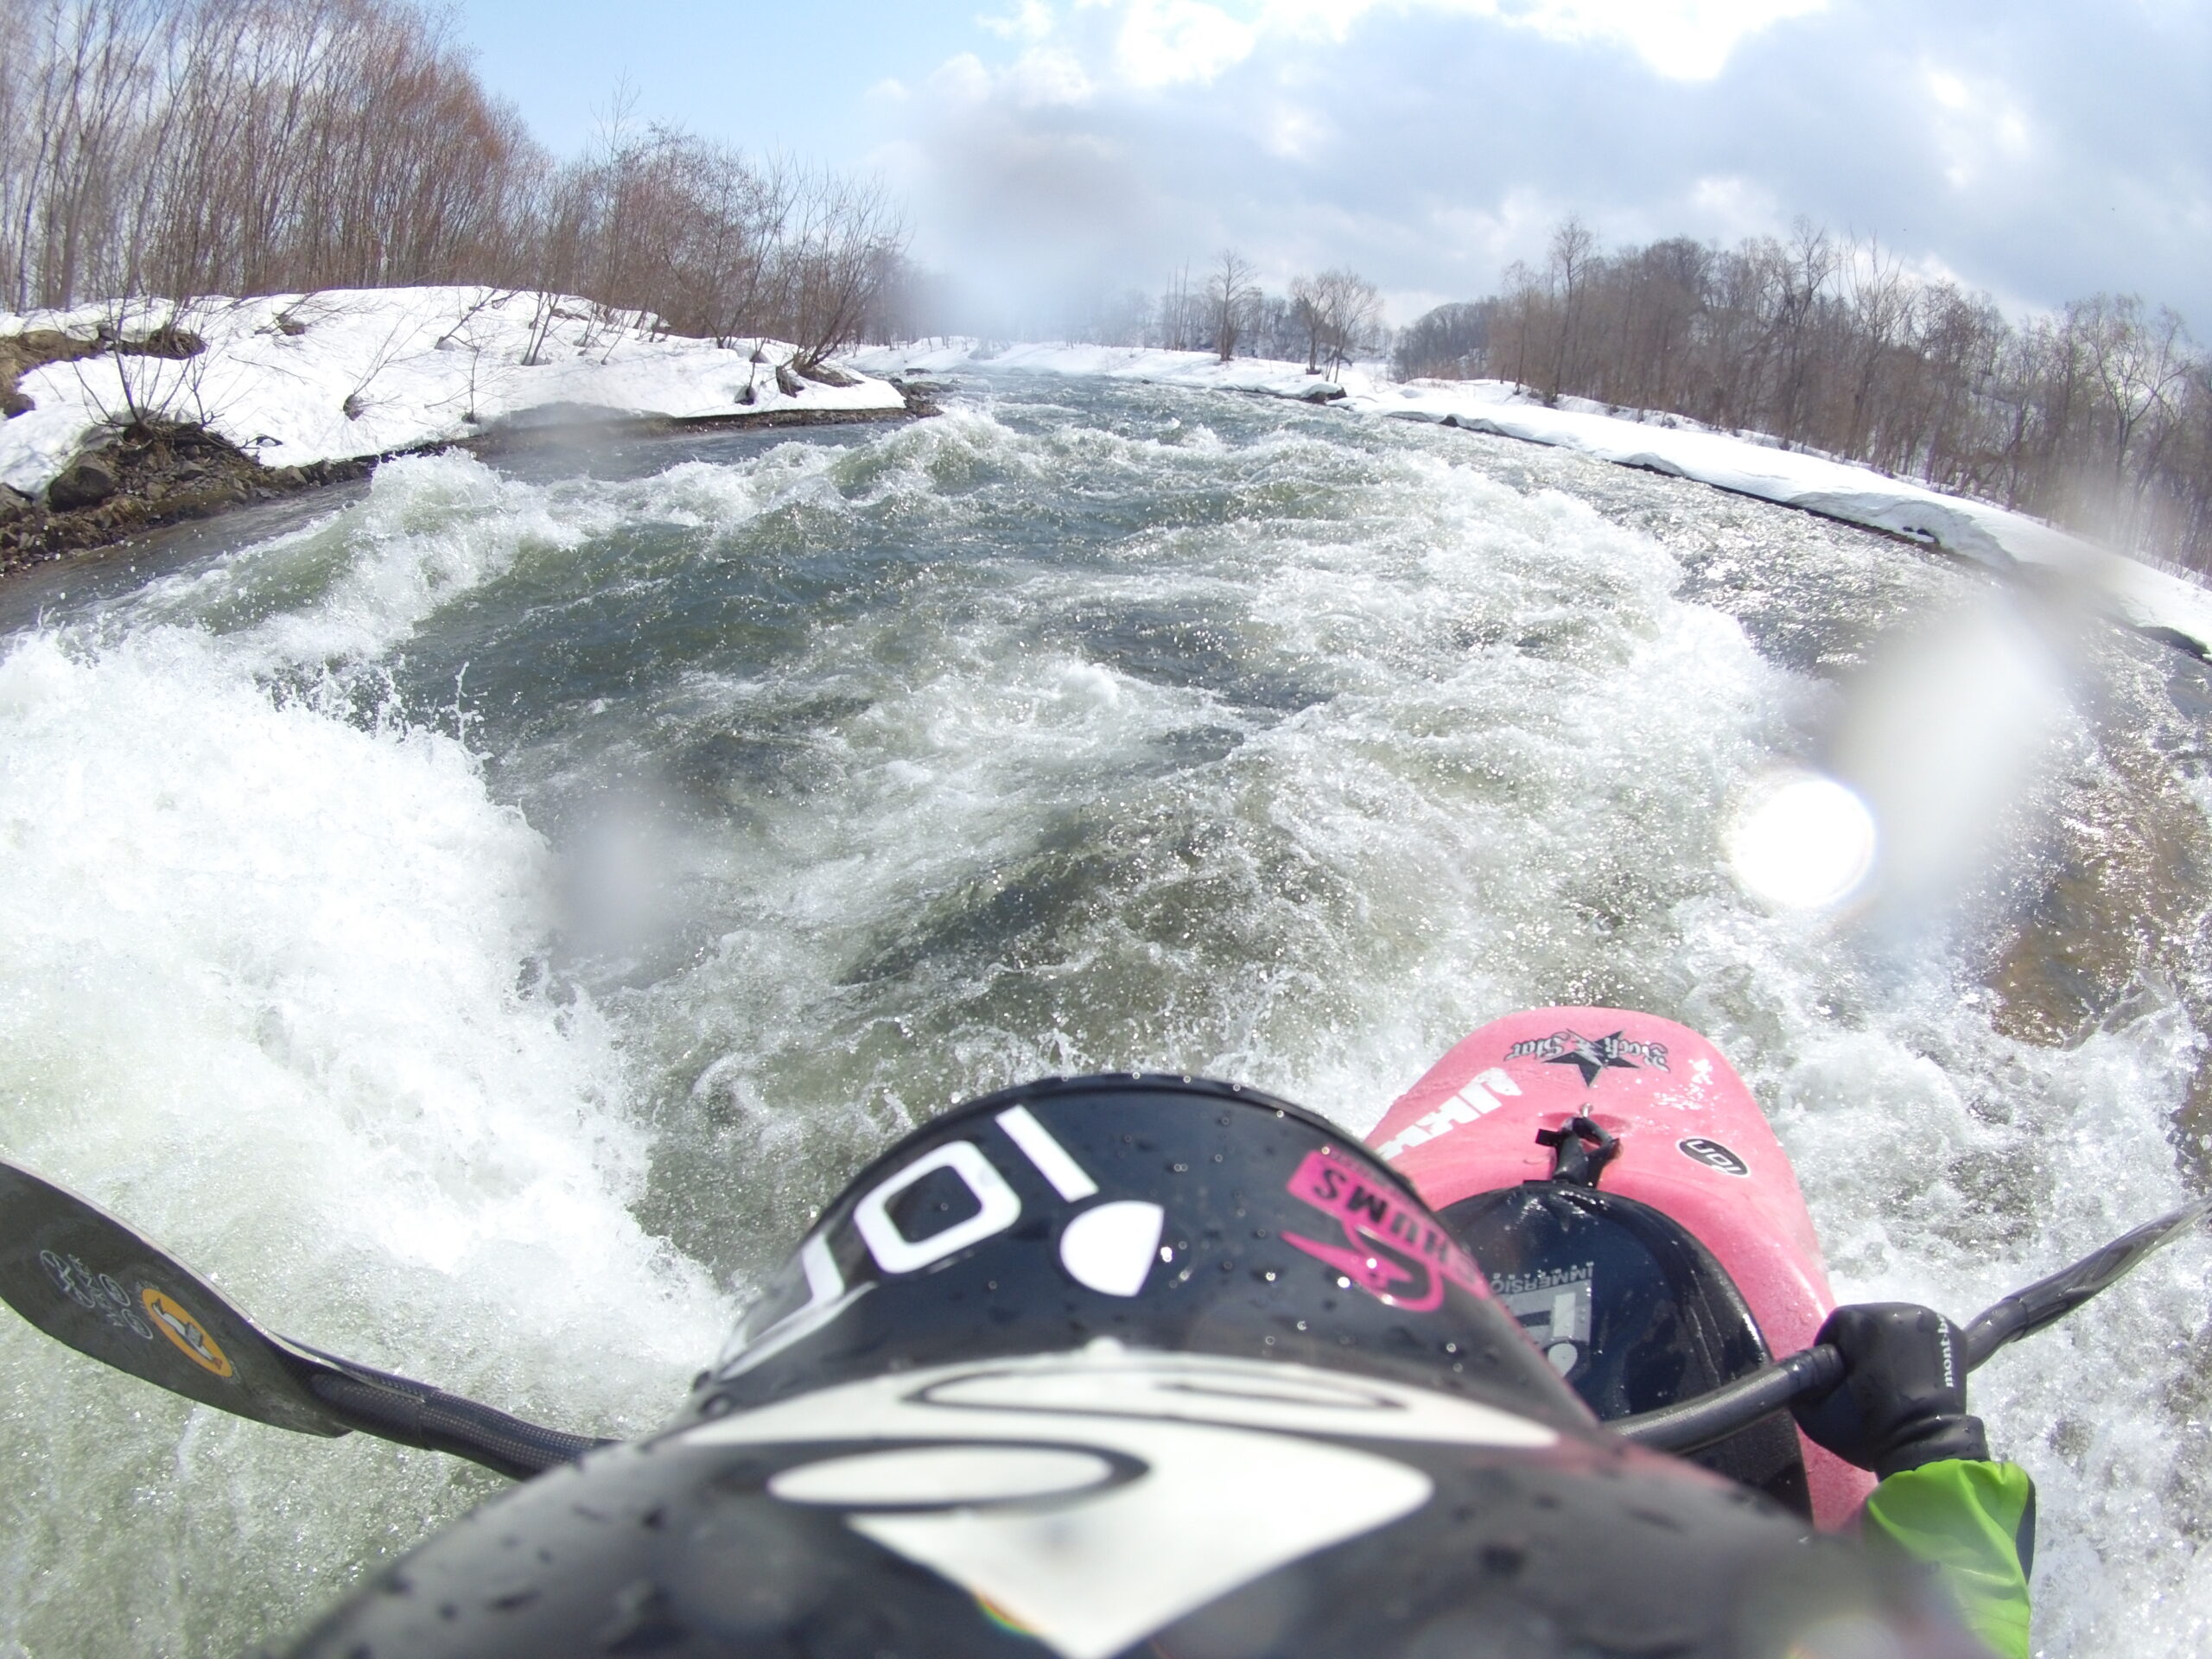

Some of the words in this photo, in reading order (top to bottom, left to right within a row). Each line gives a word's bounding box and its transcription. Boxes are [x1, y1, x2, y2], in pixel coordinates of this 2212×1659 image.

[1503, 1033, 1570, 1063] Star
[1603, 1038, 1670, 1073] Rock
[1314, 1165, 1479, 1286] HUMS
[1491, 1267, 1593, 1294] IMMERSIO
